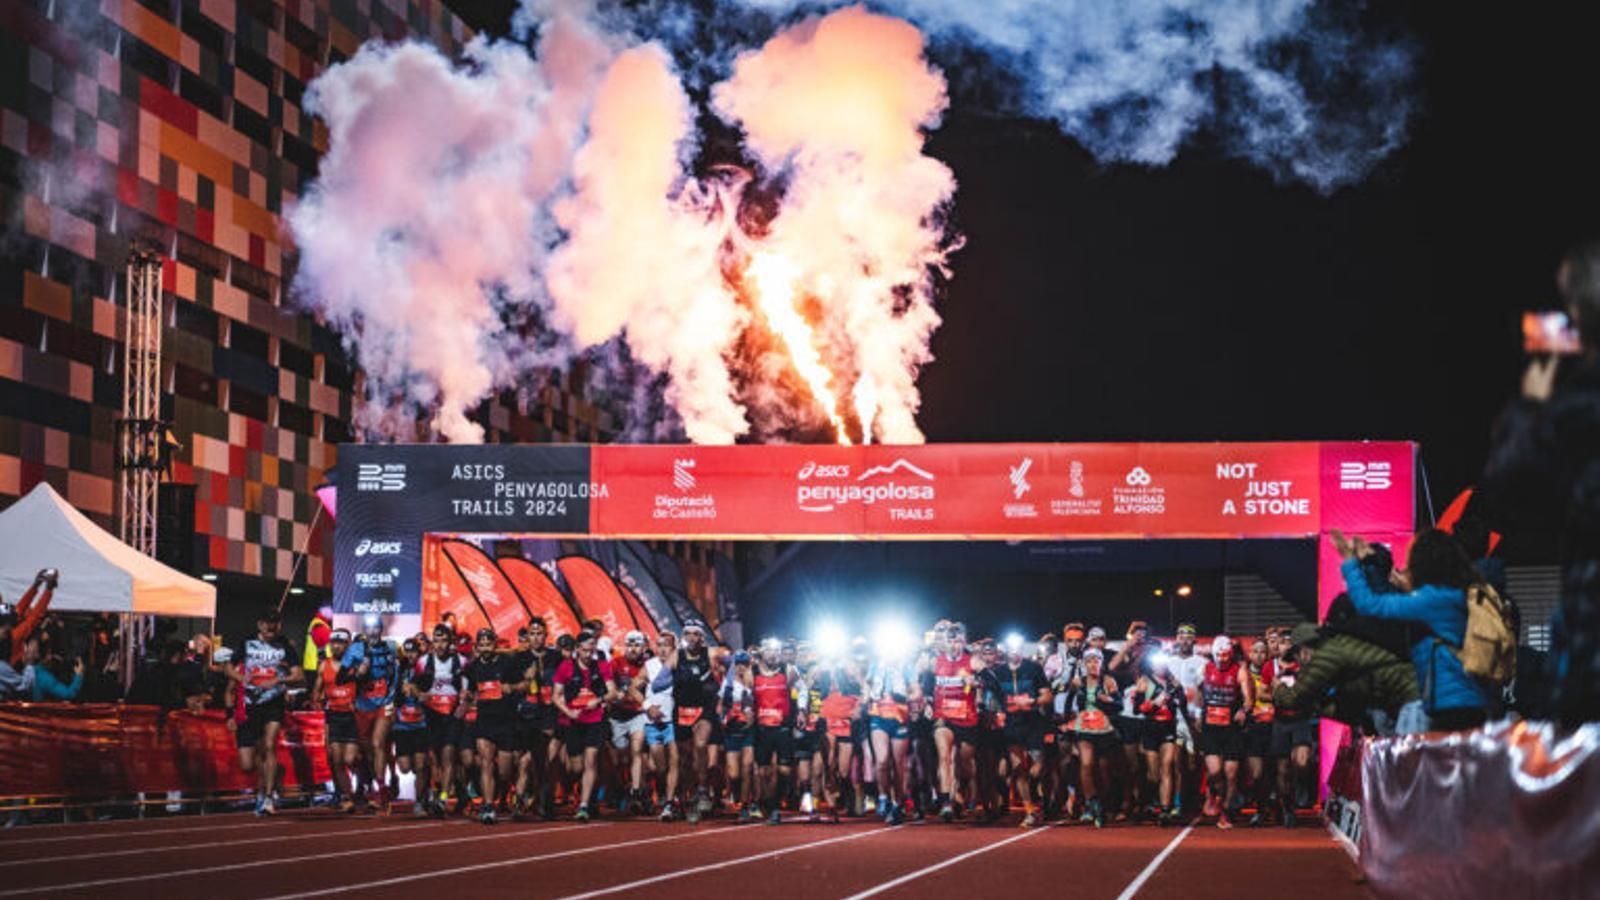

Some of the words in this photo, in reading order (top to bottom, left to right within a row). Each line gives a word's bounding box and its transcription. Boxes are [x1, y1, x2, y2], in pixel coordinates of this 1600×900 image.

[451, 465, 505, 480] ASICS
[814, 465, 849, 477] asics
[1215, 463, 1257, 479] NOT
[494, 482, 609, 498] PENYAGOLOSA
[798, 482, 934, 504] penyagolosa
[1244, 481, 1292, 497] JUST
[1113, 494, 1165, 504] TRINIDAD
[451, 500, 514, 516] TRAILS
[525, 500, 568, 516] 2024
[889, 508, 933, 520] TRAILS
[1113, 504, 1165, 514] ALFONSO
[1221, 499, 1237, 515] A
[1244, 499, 1310, 515] STONE
[370, 542, 402, 554] asics
